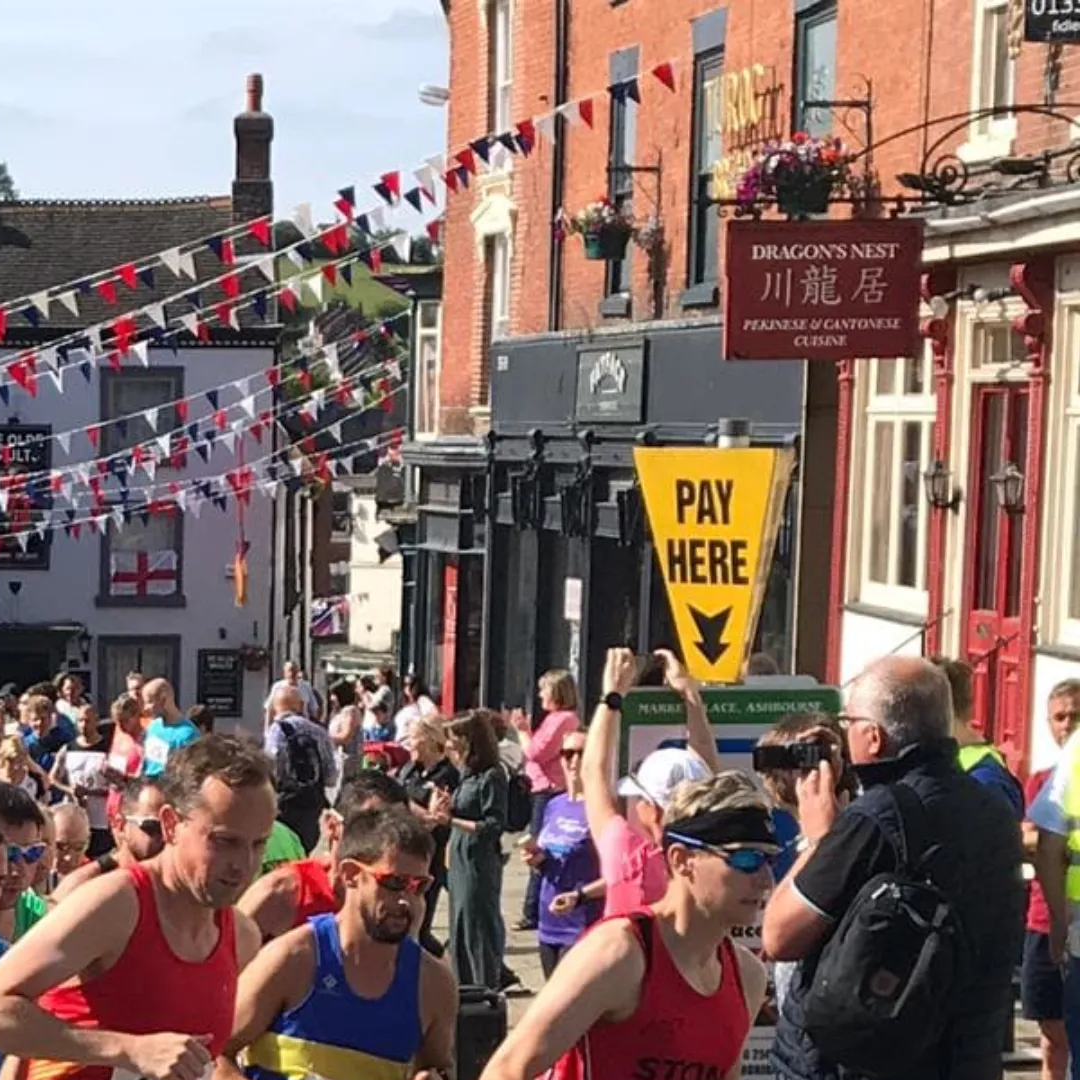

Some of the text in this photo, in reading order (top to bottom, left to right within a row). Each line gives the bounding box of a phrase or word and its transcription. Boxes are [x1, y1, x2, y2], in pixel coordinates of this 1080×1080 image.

[752, 243, 900, 260] DRAGON'S NEST
[761, 264, 888, 308] 川龍居
[743, 319, 808, 331] PEKINESE
[824, 318, 900, 330] CANTONESE
[793, 335, 848, 346] CUISINE
[676, 479, 733, 525] PAY
[667, 538, 749, 585] HERE
[638, 703, 683, 715] MARKE
